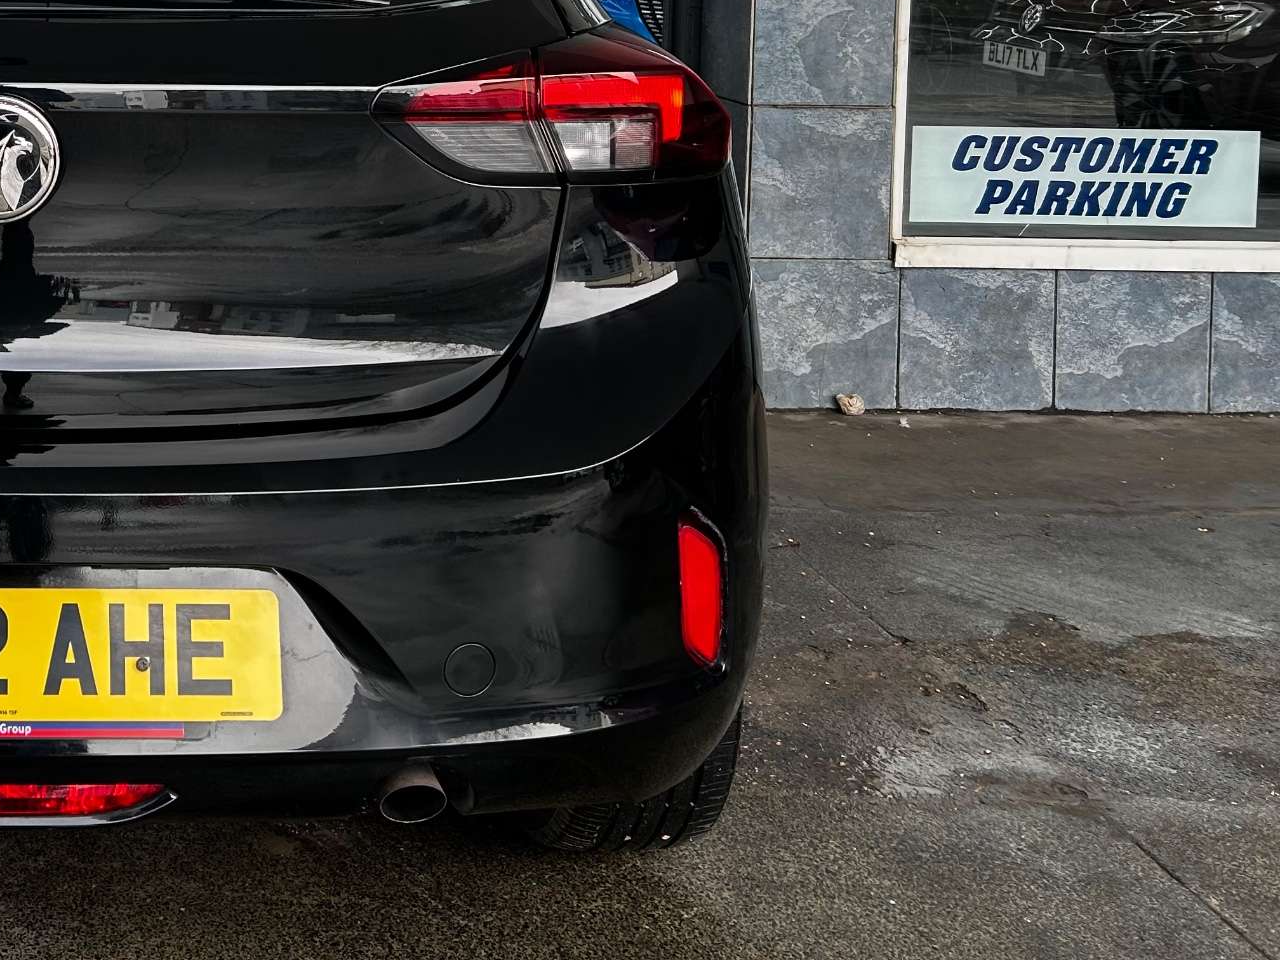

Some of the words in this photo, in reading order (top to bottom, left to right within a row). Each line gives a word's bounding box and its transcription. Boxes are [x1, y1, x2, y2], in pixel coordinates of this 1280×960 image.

[988, 42, 1013, 66] BL17
[1016, 47, 1040, 72] TLX
[951, 134, 1219, 175] CUSTOMER
[974, 178, 1193, 219] PARKING
[42, 602, 234, 696] AHE
[0, 723, 32, 737] Group
